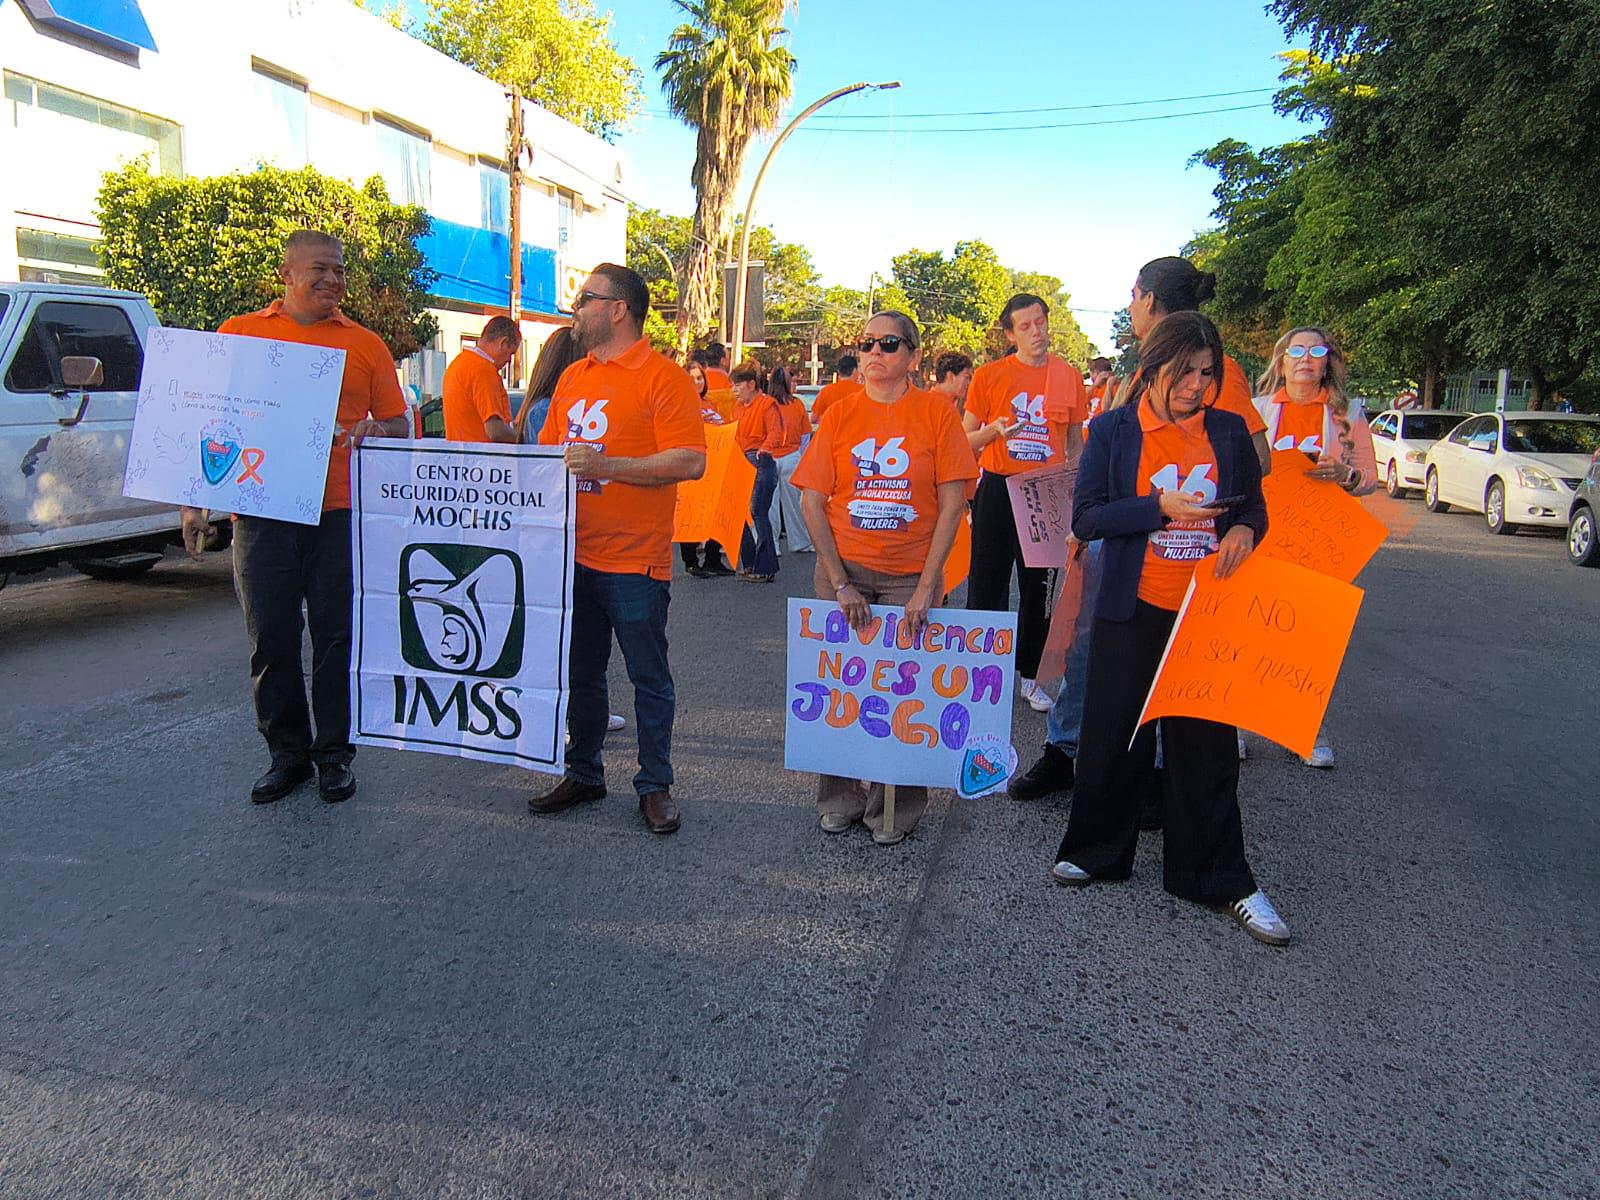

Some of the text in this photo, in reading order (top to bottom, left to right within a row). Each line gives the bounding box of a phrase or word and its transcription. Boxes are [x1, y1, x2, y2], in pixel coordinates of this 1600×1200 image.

[567, 399, 609, 441] 16
[851, 436, 910, 478] 16
[416, 464, 513, 485] CENTRO DE
[857, 480, 908, 490] DE ACTIVISMO
[381, 483, 546, 508] SEGURIDAD SOCIAL
[1291, 480, 1360, 539] FUTURO
[412, 505, 513, 532] MOCHIS
[861, 518, 899, 530] MUJERES
[1163, 547, 1206, 560] MUJERES
[1247, 594, 1297, 633] NO
[818, 650, 867, 687] NO
[871, 659, 921, 696] ES
[393, 675, 523, 740] IMSS
